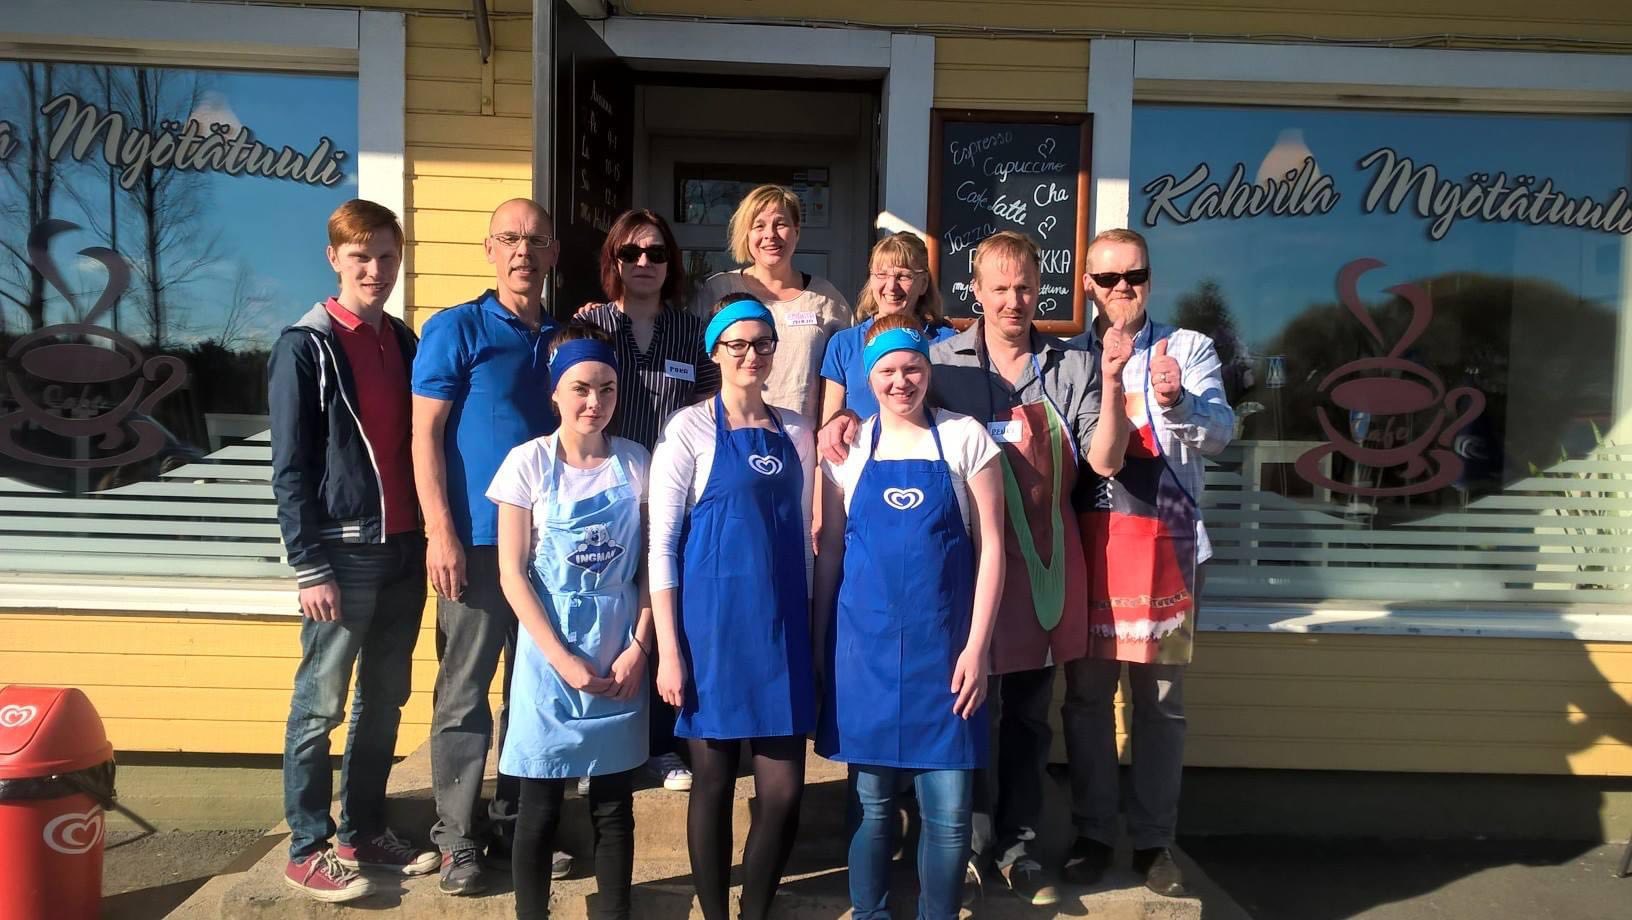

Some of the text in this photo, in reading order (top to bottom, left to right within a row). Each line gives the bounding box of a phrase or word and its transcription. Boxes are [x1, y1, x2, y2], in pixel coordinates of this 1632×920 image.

[40, 92, 346, 190] Myötätuuli
[950, 131, 1013, 168] Espresso
[990, 195, 1027, 225] latte
[1144, 156, 1341, 228] Kahvila
